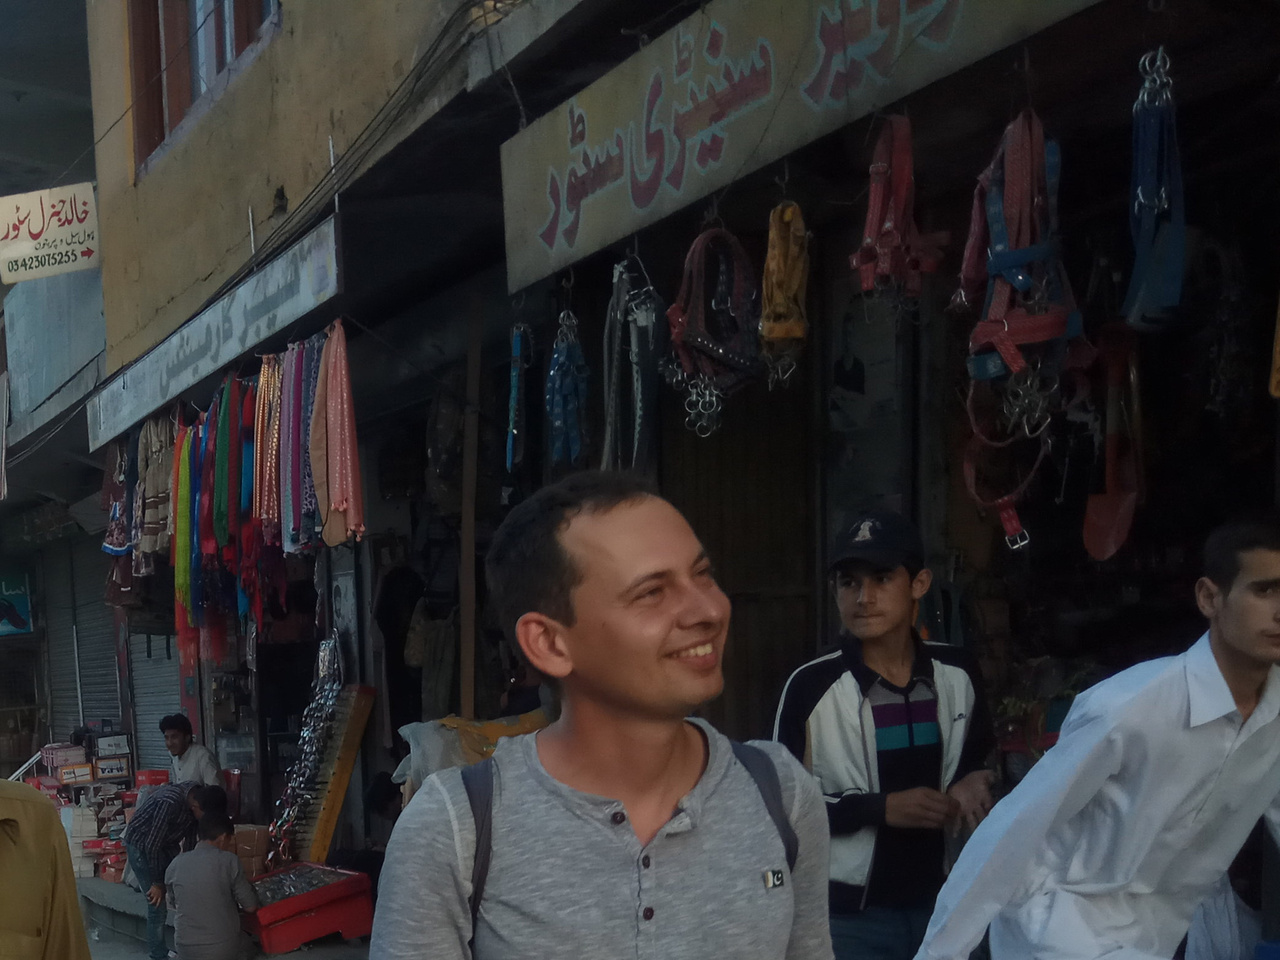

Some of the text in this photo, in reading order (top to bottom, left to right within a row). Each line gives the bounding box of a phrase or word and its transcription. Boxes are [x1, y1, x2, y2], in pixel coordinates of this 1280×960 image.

[537, 96, 625, 250] سٹور
[0, 193, 89, 241] خالد جنرل سٹور
[7, 249, 78, 273] 03423075255
